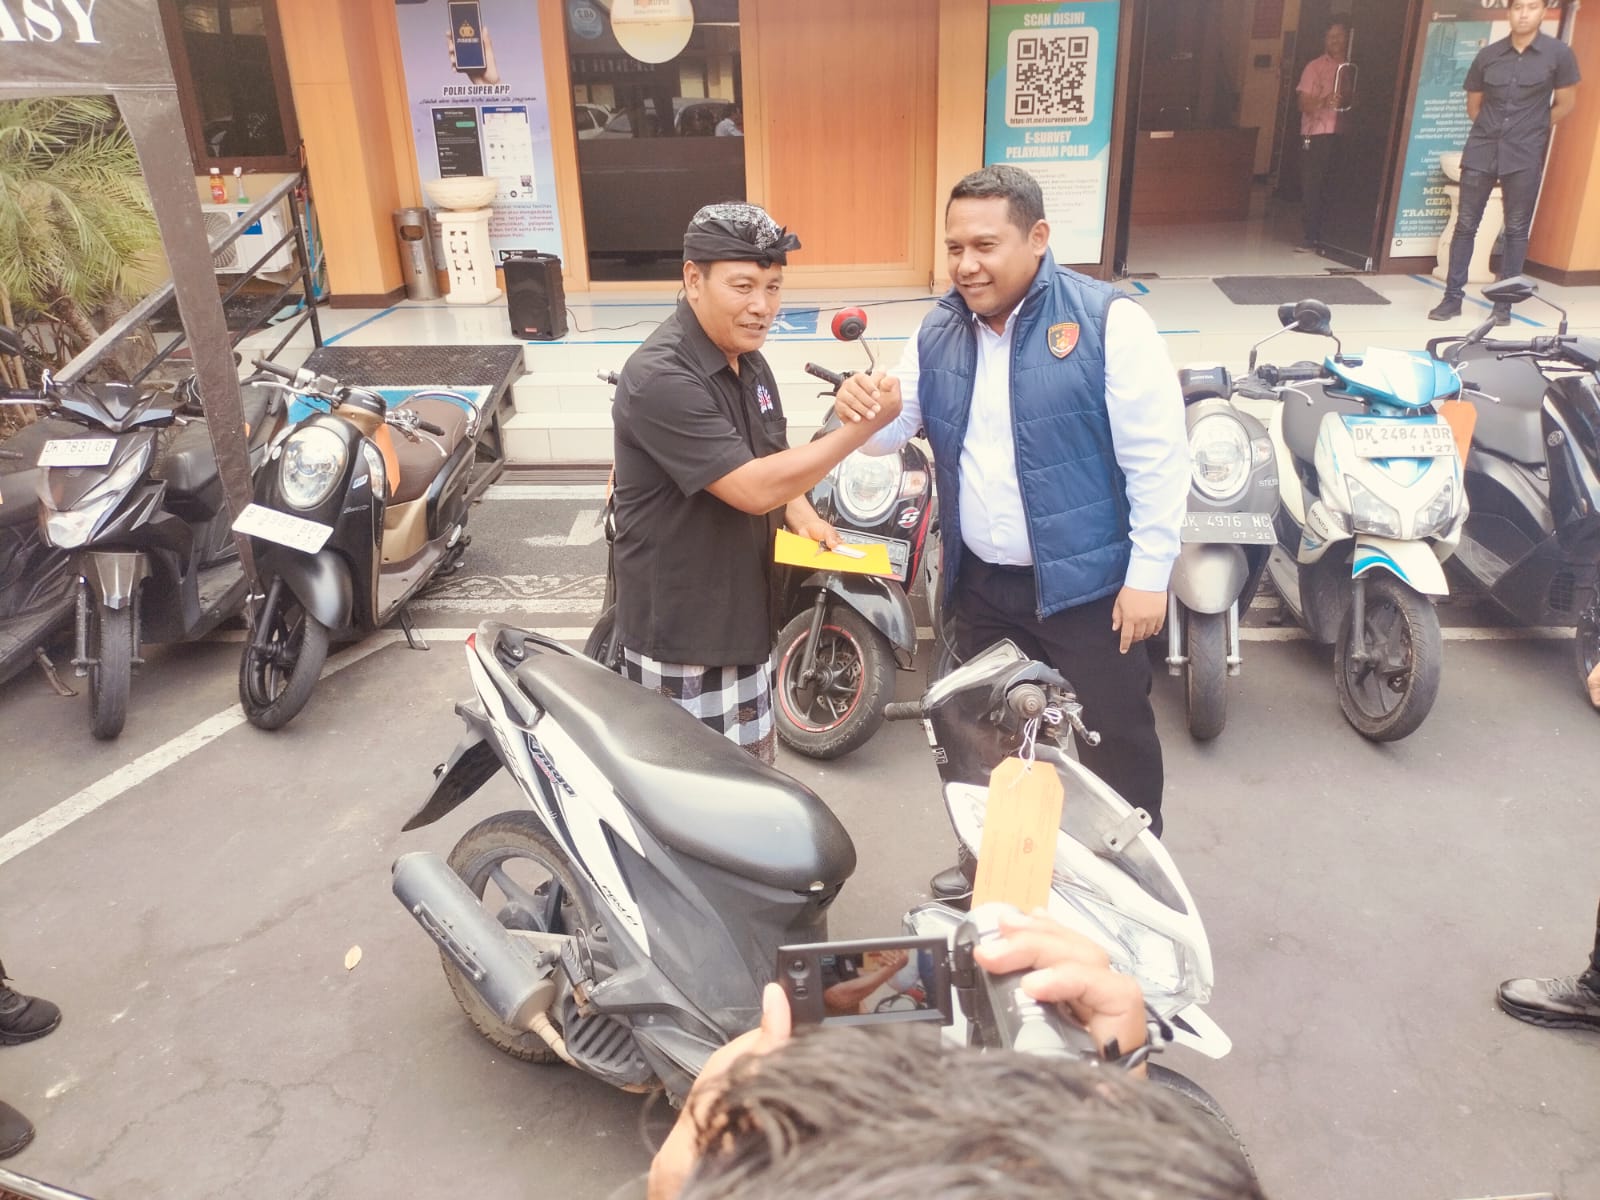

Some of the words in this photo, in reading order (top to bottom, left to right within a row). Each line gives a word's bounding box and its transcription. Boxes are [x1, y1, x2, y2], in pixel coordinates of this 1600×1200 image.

[1023, 13, 1052, 27] SCAN
[1053, 12, 1085, 25] DISINI
[443, 86, 466, 96] POLRI
[467, 85, 493, 95] SUPER
[494, 84, 511, 95] APP
[1025, 130, 1072, 144] E-SURVEY
[1006, 145, 1059, 159] PELAYANAN
[1060, 144, 1089, 157] POLRI
[1355, 428, 1375, 441] DK
[1206, 515, 1242, 528] 4976
